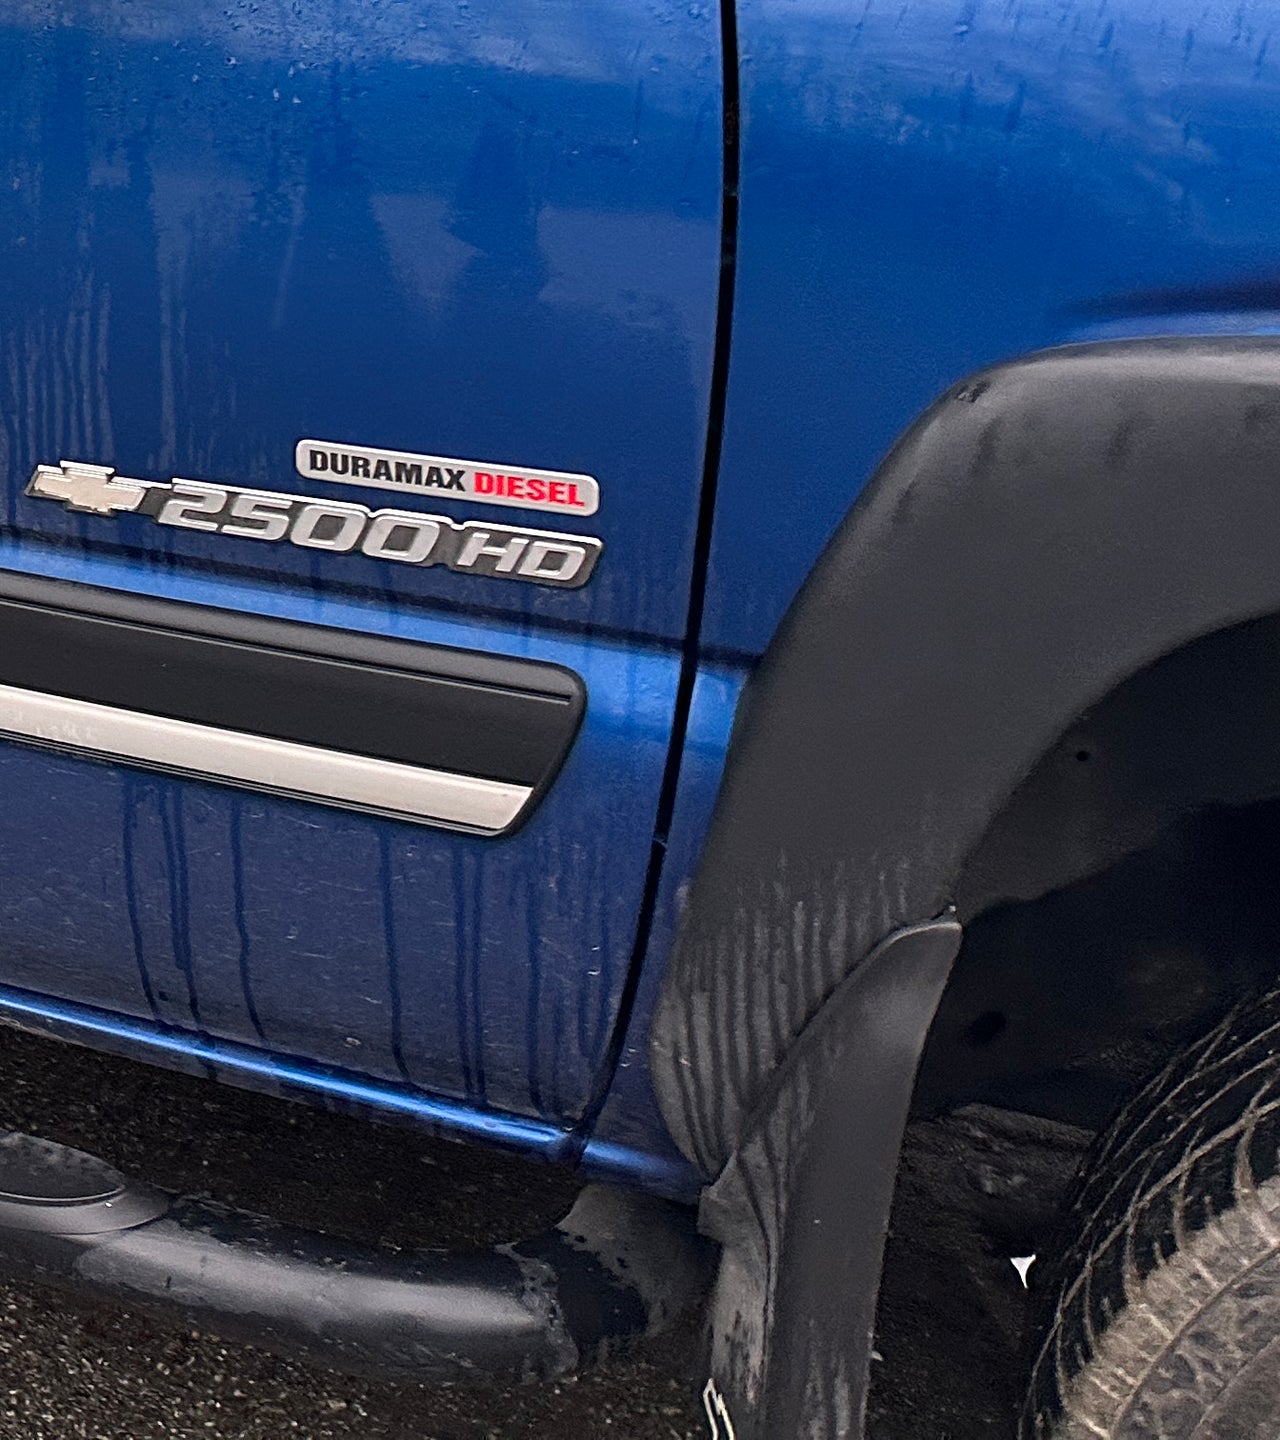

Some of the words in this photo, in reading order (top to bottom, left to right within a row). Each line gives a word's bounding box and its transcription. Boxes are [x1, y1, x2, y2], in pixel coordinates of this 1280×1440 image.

[308, 448, 466, 492] DURAMAX
[473, 473, 586, 508] DIESEL
[156, 484, 443, 563] 2500
[455, 534, 587, 582] HD
